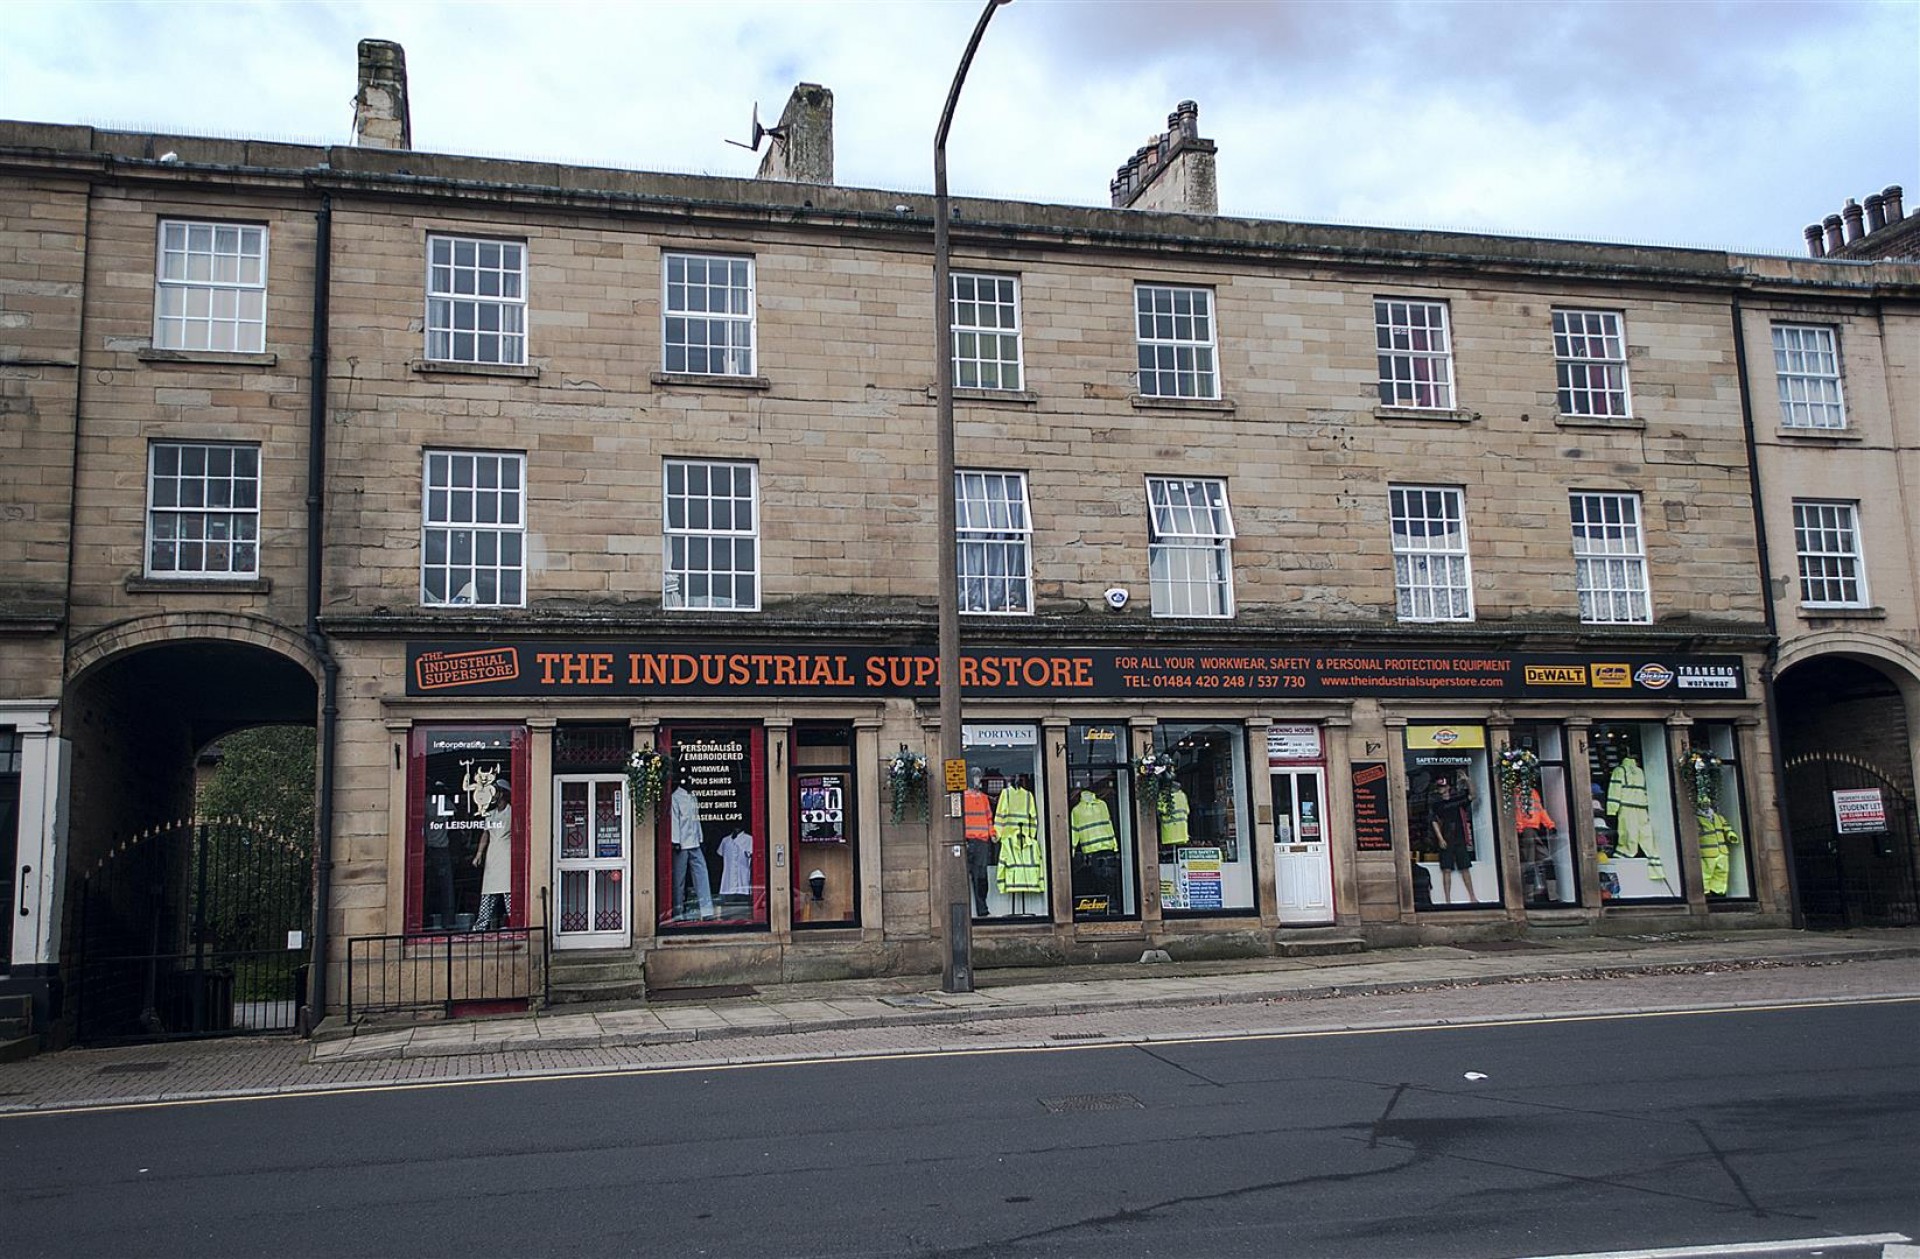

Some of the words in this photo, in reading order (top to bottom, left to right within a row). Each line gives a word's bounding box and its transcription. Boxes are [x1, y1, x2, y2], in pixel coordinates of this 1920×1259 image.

[422, 651, 444, 661] THE
[424, 654, 506, 673] INDUSTRIAL
[1115, 657, 1138, 669] FOR
[1141, 657, 1162, 669] ALL
[1164, 657, 1195, 669] YOUR
[1200, 657, 1268, 671] WORKWEAR,
[1270, 657, 1311, 670] SAFETY
[1316, 659, 1324, 670] &
[1326, 658, 1383, 670] PERSONAL
[1385, 659, 1450, 671] PROTECTION
[1453, 659, 1511, 672] EQUIPMENT
[425, 664, 513, 684] SUPERSTORE
[536, 653, 614, 685] THE
[628, 654, 856, 686] INDUSTRIAL
[1678, 666, 1733, 676] TRANEMO
[1123, 675, 1151, 688] TEL:
[1153, 675, 1192, 688] 01484
[1195, 675, 1220, 688] 420
[1222, 675, 1246, 688] 248
[1248, 675, 1254, 687] /
[1257, 675, 1279, 687] 537
[1282, 675, 1306, 688] 730
[1321, 675, 1504, 688] www.theindustrialsuperstore.com
[1686, 679, 1729, 688] workwear
[978, 730, 1033, 738] PORTWEST
[433, 740, 486, 750] Incorporating
[680, 744, 743, 752] PERSONALISED
[684, 753, 744, 761] EMBROIDERED
[691, 765, 730, 773] WORKWEAR
[691, 777, 708, 785] POLO
[709, 777, 732, 785] SHIRTS
[691, 789, 737, 797] SWEATSHIRTS
[715, 801, 738, 809] SHIRTS
[725, 813, 743, 821] CAPS
[429, 821, 444, 830] for
[445, 820, 486, 830] LEISURE
